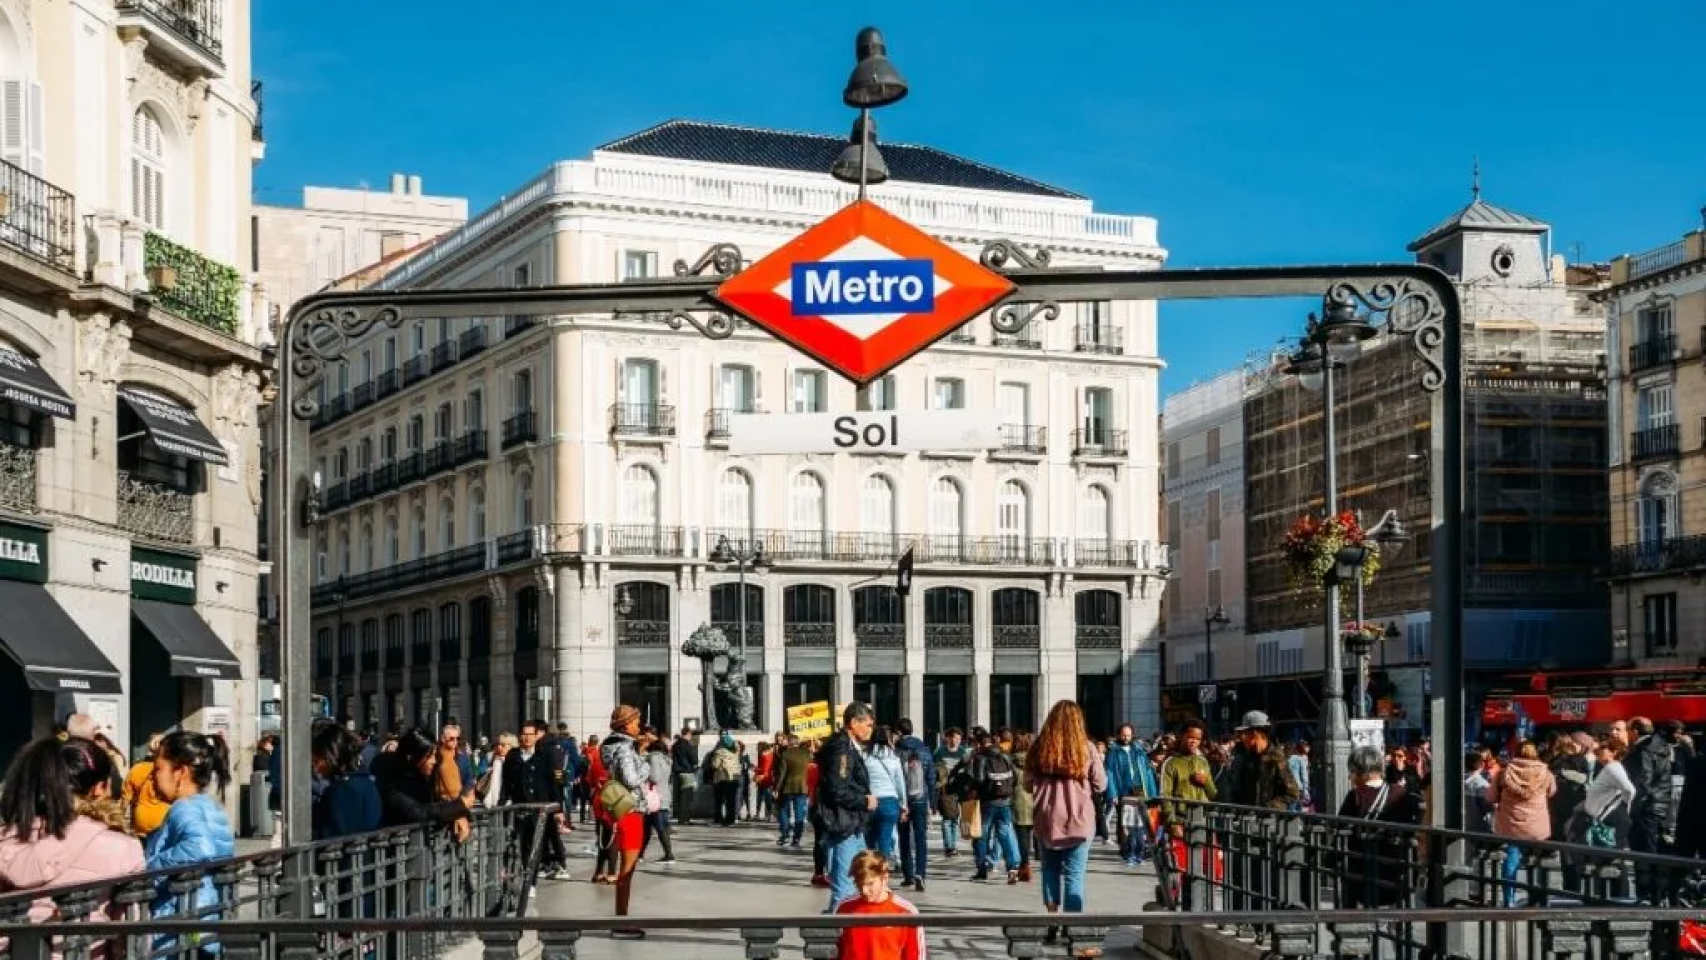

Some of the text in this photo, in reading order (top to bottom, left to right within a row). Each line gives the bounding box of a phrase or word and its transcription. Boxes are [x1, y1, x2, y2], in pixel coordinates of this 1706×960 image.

[805, 269, 924, 304] Metro
[833, 415, 899, 448] Sol
[130, 561, 195, 589] RODILLA
